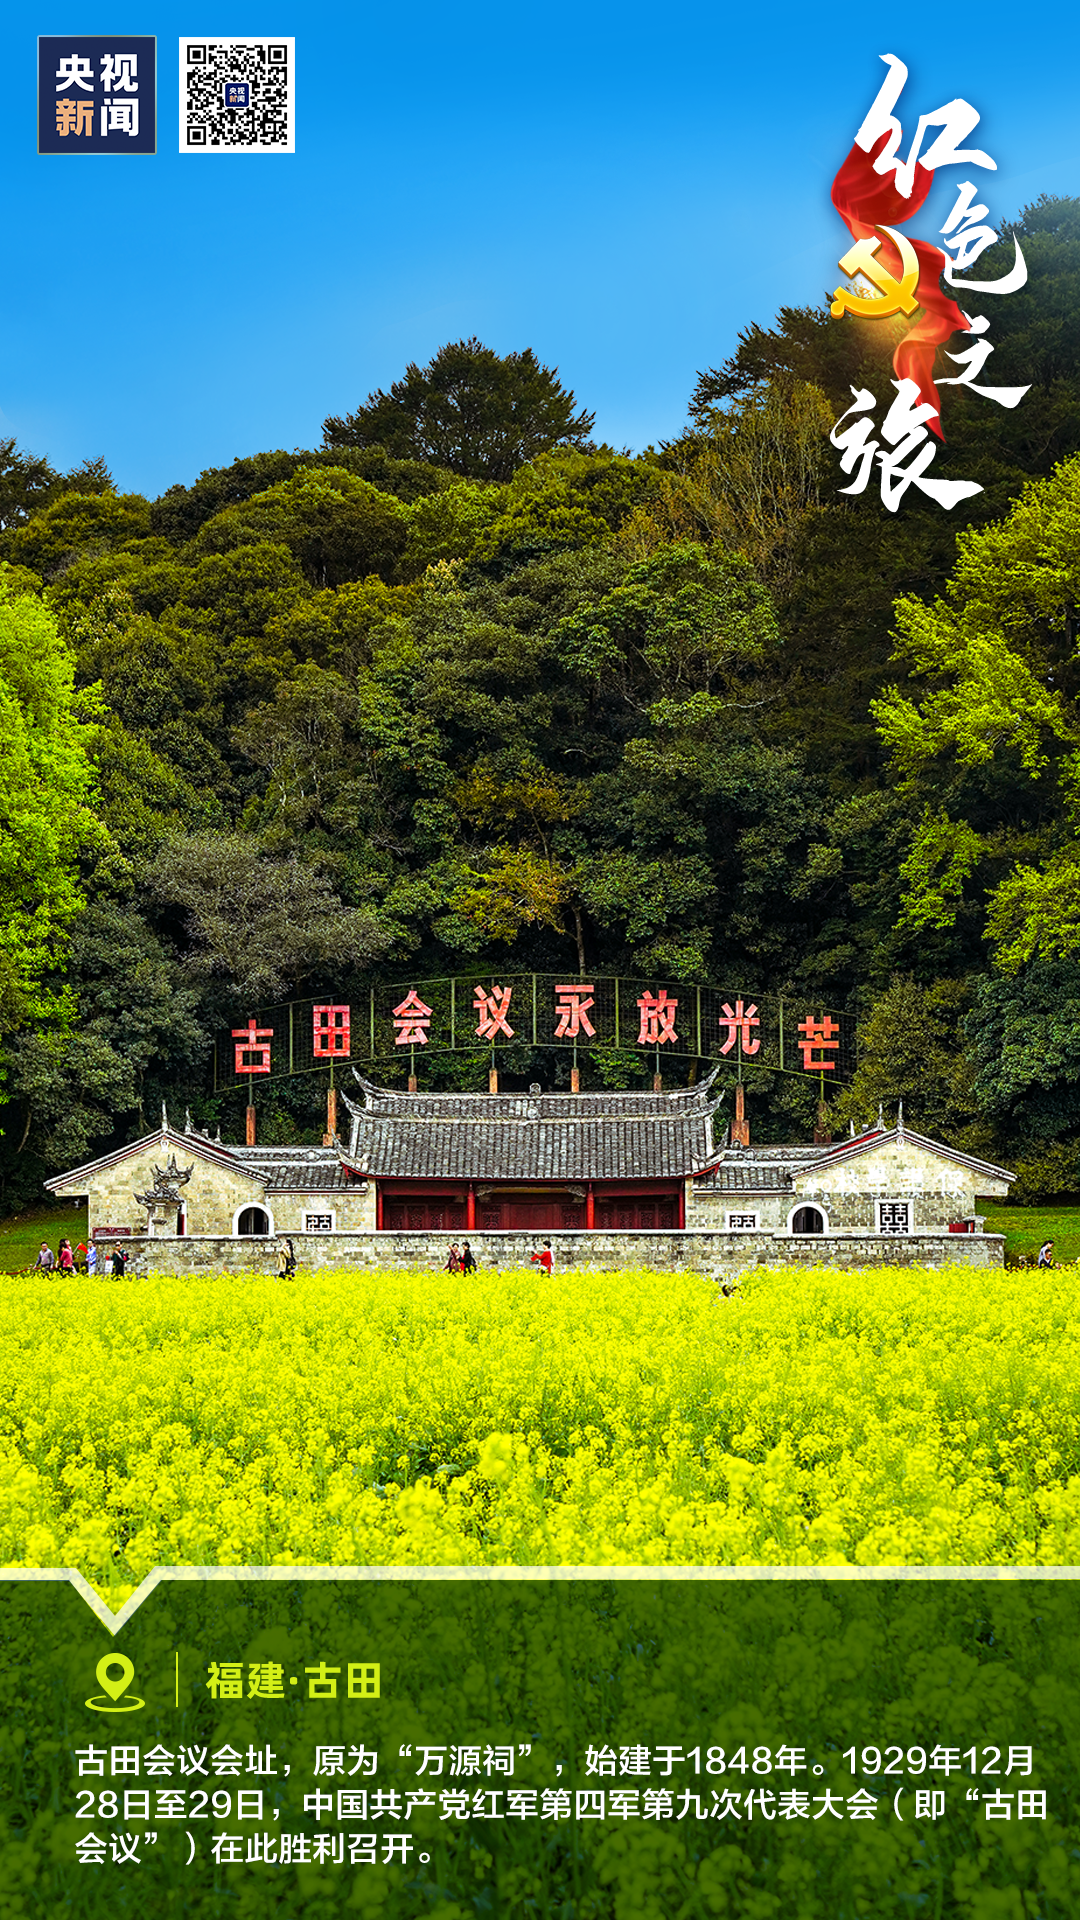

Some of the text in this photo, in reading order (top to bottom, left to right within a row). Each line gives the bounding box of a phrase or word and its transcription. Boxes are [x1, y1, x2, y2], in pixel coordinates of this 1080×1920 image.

[231, 984, 840, 1074] 古田会议永放光芒
